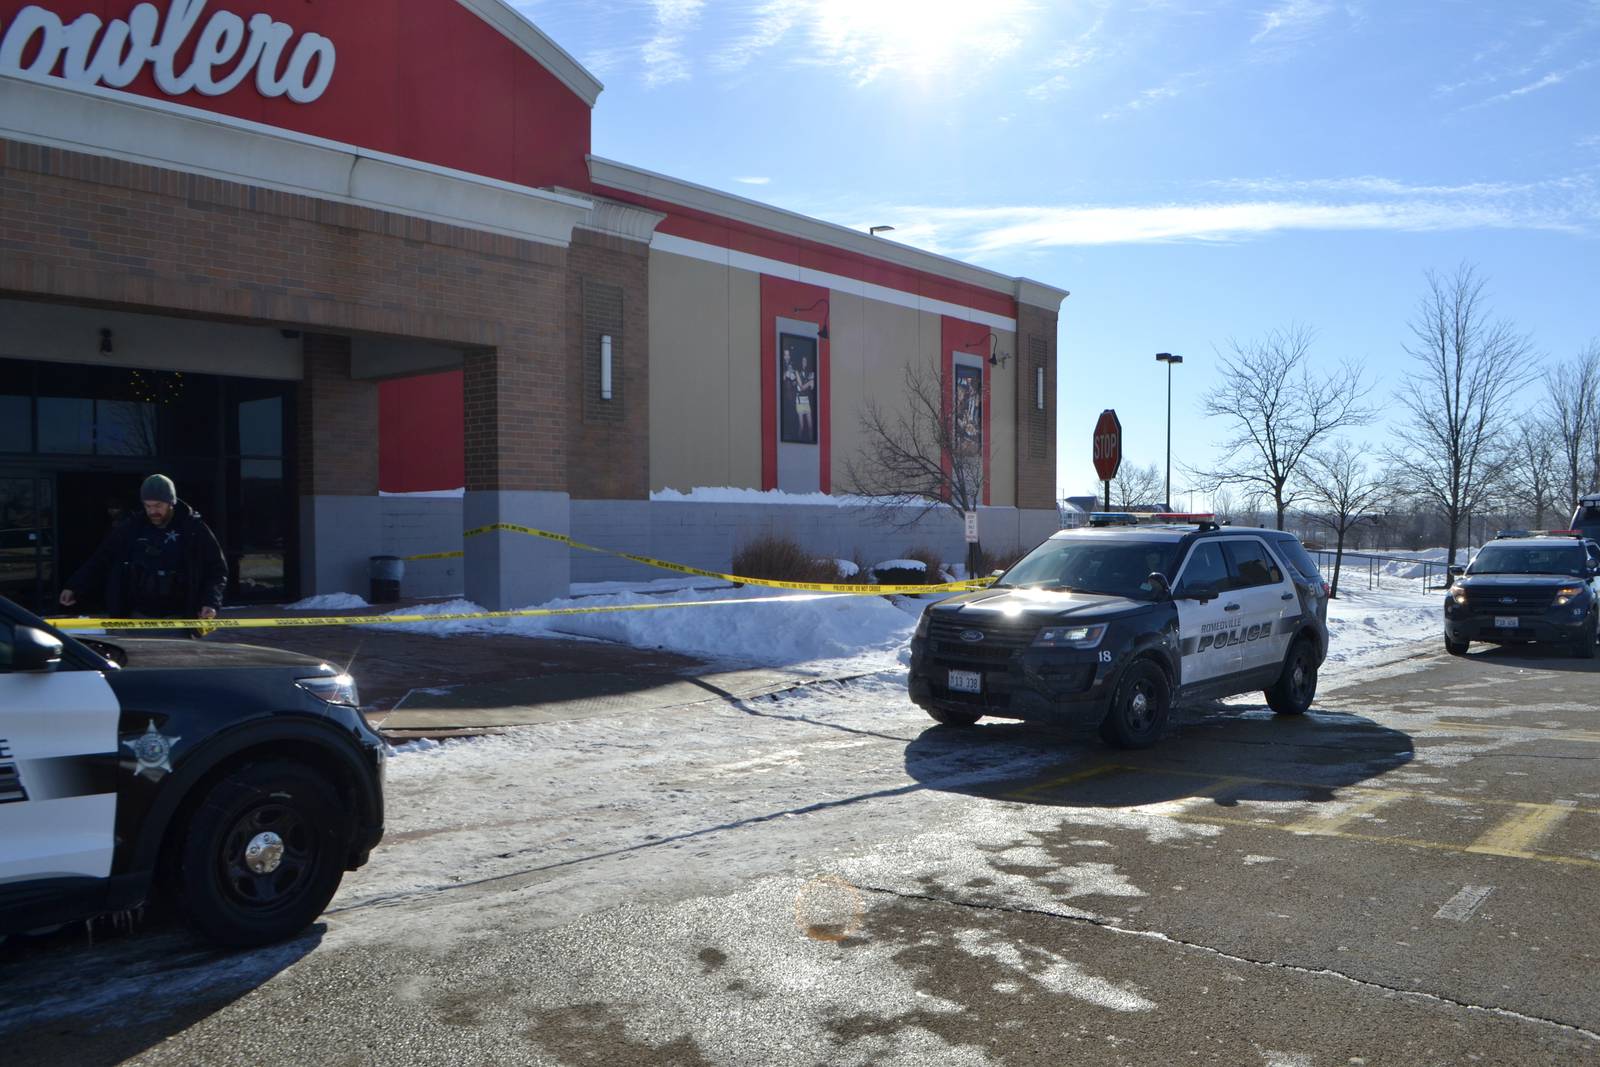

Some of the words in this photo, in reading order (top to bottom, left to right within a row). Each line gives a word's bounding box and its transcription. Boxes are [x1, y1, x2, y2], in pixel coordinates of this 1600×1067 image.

[1094, 433, 1118, 460] STOP
[1197, 621, 1273, 653] POLICE
[1200, 621, 1242, 634] ROMEOVILLE
[1098, 650, 1112, 663] 18
